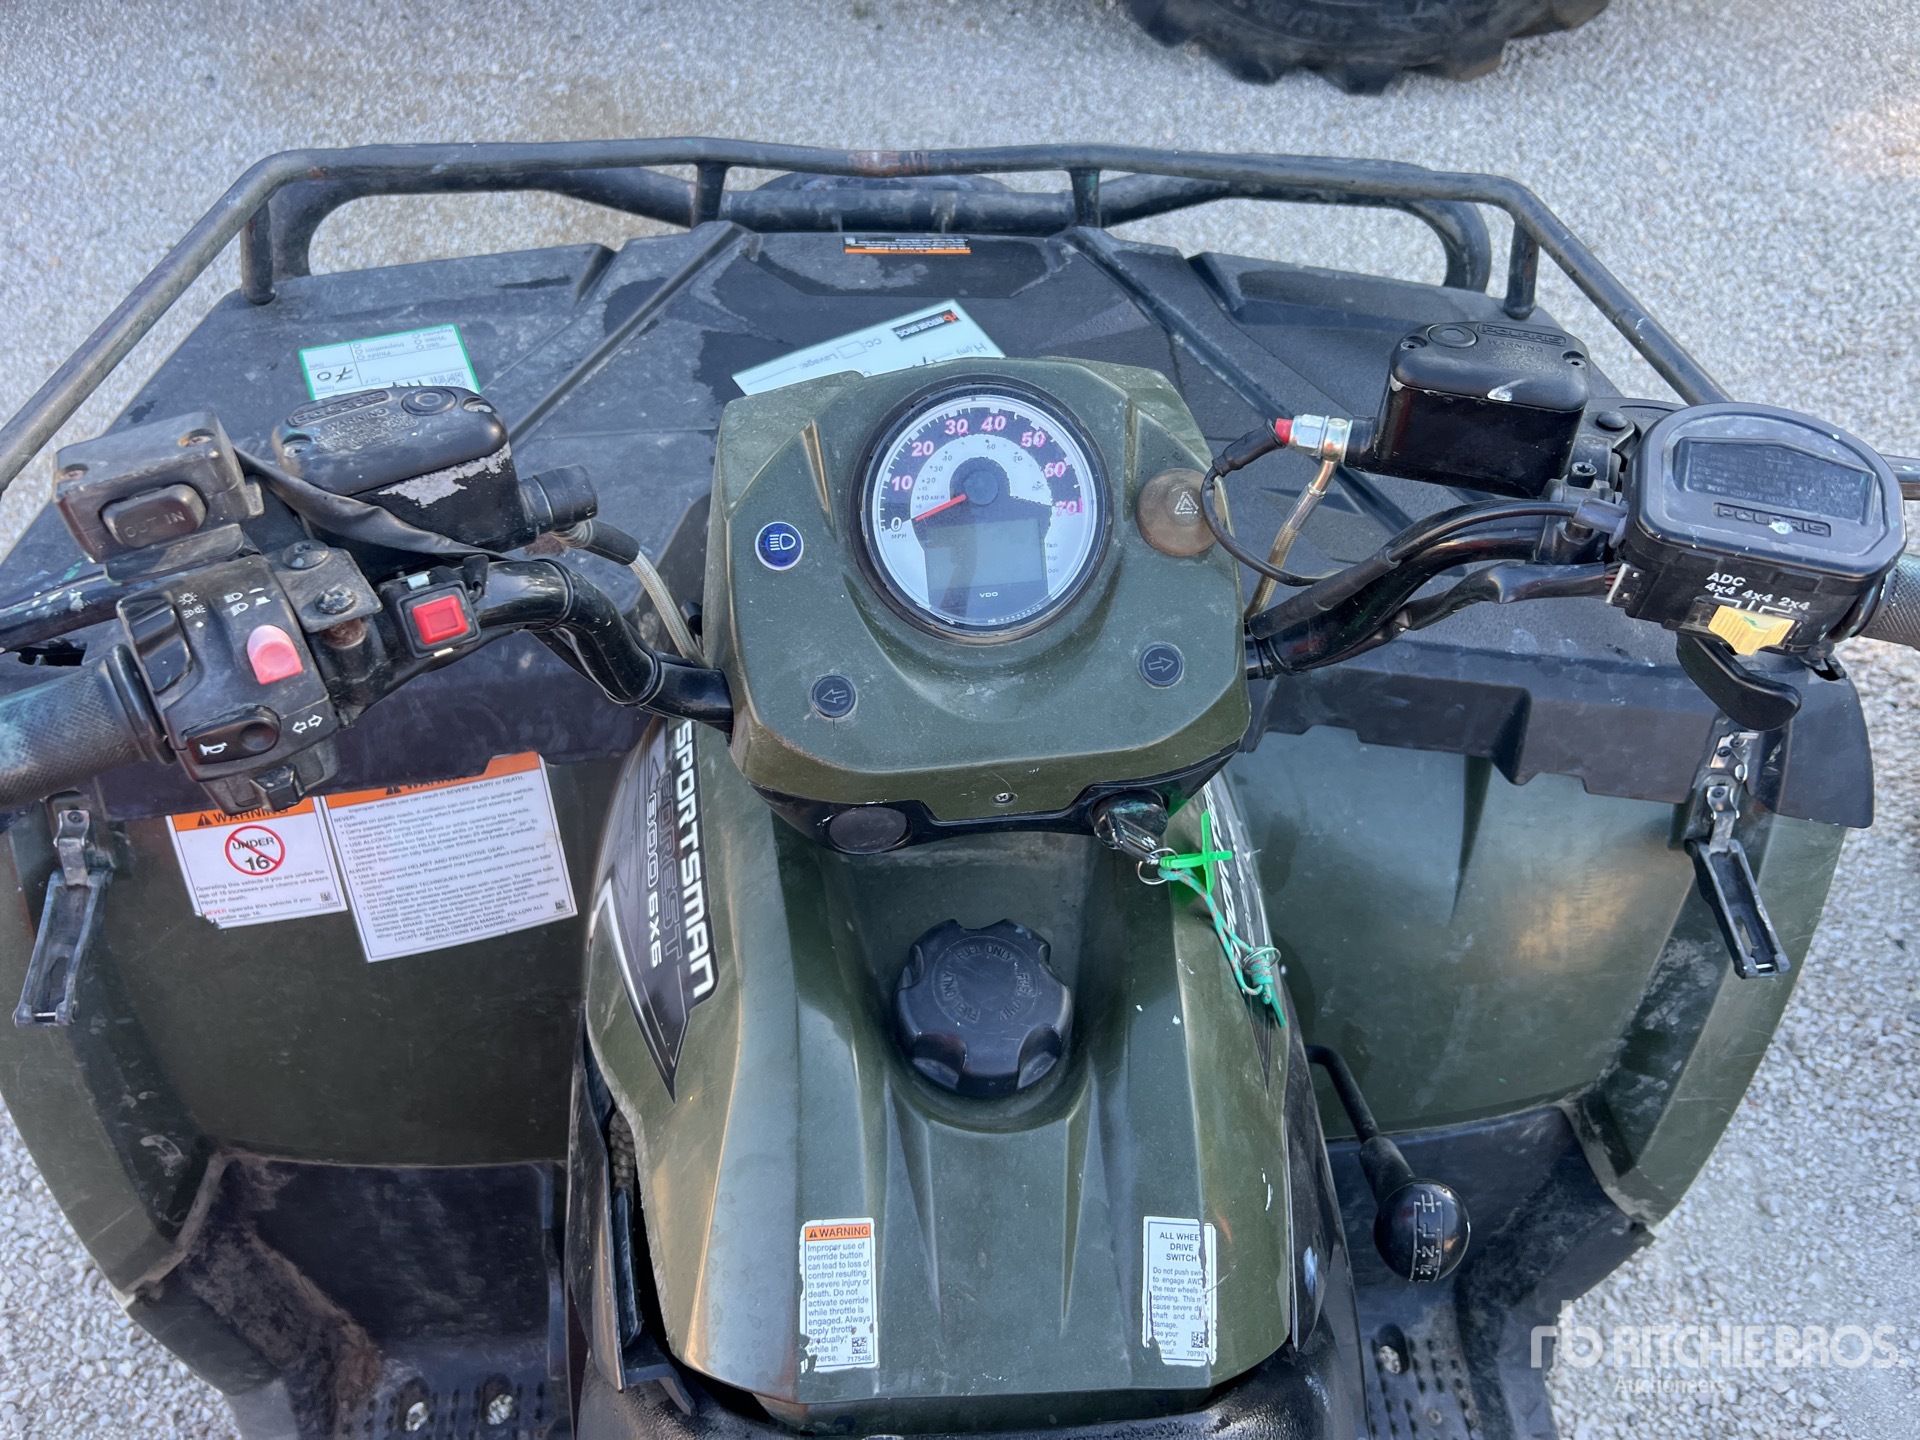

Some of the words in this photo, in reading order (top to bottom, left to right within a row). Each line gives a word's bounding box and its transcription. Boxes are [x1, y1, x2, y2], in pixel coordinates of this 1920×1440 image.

[944, 419, 969, 435] 30
[981, 415, 1007, 431] 40
[1021, 431, 1046, 447] 50
[911, 441, 934, 457] 20
[1044, 461, 1067, 477] 60
[892, 475, 913, 491] 10
[1055, 500, 1078, 516] 70
[165, 511, 186, 525] IN
[890, 517, 902, 532] 0
[1706, 572, 1746, 586] ADC
[1705, 582, 1736, 595] 4x4
[1742, 590, 1773, 603] 4x4
[1778, 597, 1810, 611] 2x4
[446, 786, 469, 794] SEVERE
[471, 781, 493, 789] INJURY
[232, 836, 275, 850] UNDER
[244, 855, 270, 871] 16
[658, 769, 683, 962] FOREST
[675, 720, 715, 999] SPORTSMAN
[195, 883, 227, 892] Operating
[955, 946, 980, 960] FUEL
[986, 945, 1014, 961] ONLY
[1421, 1194, 1435, 1213] H
[820, 1226, 868, 1238] WARNING
[1159, 1232, 1174, 1240] ALL
[1176, 1233, 1200, 1241] WHEE
[1423, 1223, 1435, 1238] L
[808, 1244, 841, 1253] Improper
[1170, 1243, 1194, 1251] DRIVE
[1421, 1245, 1435, 1258] N
[808, 1253, 838, 1261] override
[840, 1252, 863, 1260] button
[1166, 1253, 1197, 1262] SWITCH
[822, 1262, 837, 1270] lead
[863, 1259, 869, 1267] of
[1419, 1264, 1433, 1275] R
[808, 1271, 834, 1279] control
[836, 1269, 867, 1278] resulting
[842, 1279, 861, 1288] injury
[1162, 1278, 1184, 1286] engage
[808, 1290, 831, 1298] death.
[1153, 1295, 1178, 1303] spinning.
[808, 1299, 837, 1307] activate
[840, 1296, 869, 1305] override
[808, 1308, 828, 1316] while
[830, 1306, 856, 1315] throttle
[808, 1316, 843, 1327] engaged.
[845, 1315, 870, 1324] Always
[1153, 1321, 1178, 1329] damage.
[808, 1327, 829, 1336] apply
[808, 1345, 829, 1353] while
